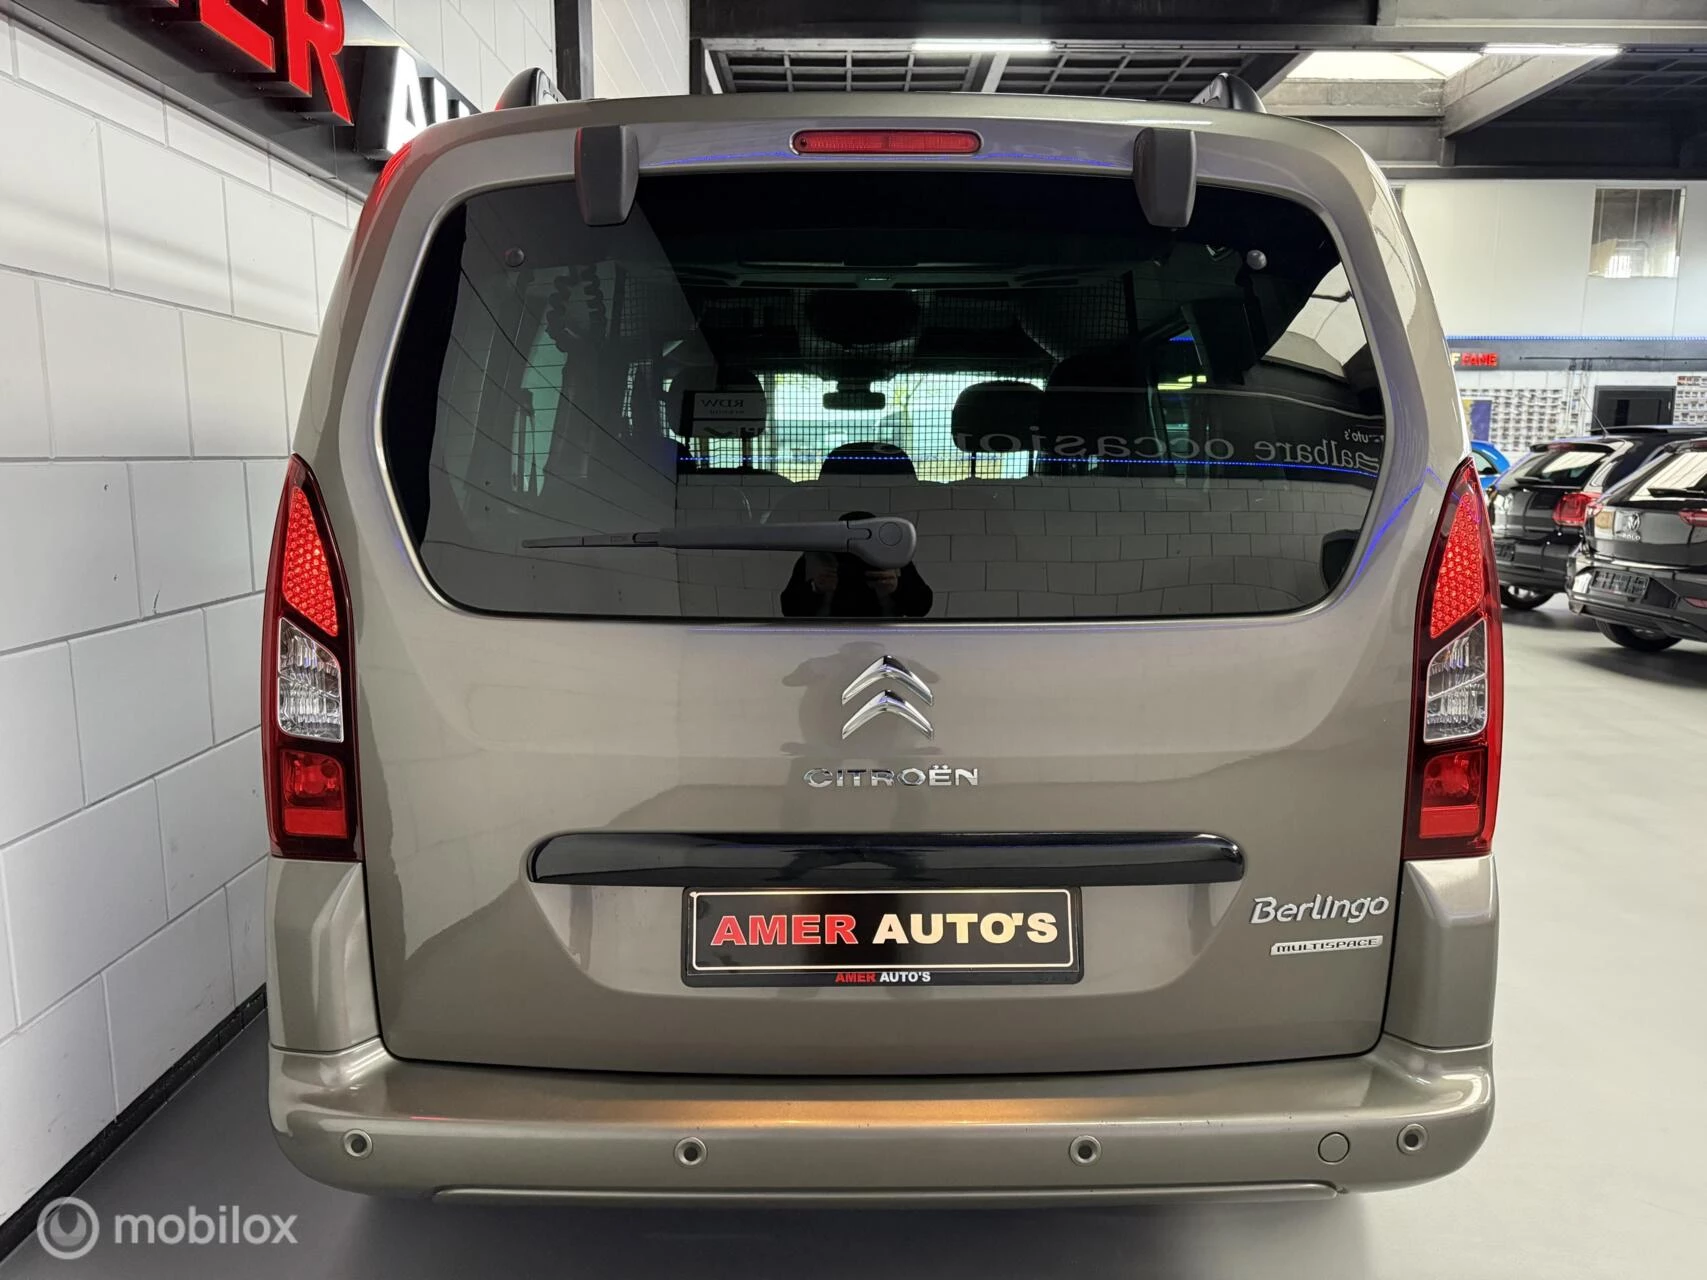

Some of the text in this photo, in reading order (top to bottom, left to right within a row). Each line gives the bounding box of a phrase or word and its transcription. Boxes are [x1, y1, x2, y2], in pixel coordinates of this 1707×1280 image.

[1462, 352, 1498, 367] FAME
[802, 764, 980, 788] CITROËN
[1250, 893, 1390, 924] Berlingo
[710, 911, 1059, 946] AMER AUTO'S
[1276, 937, 1379, 953] MULTISPACE
[835, 970, 932, 984] AMER AUTO'S
